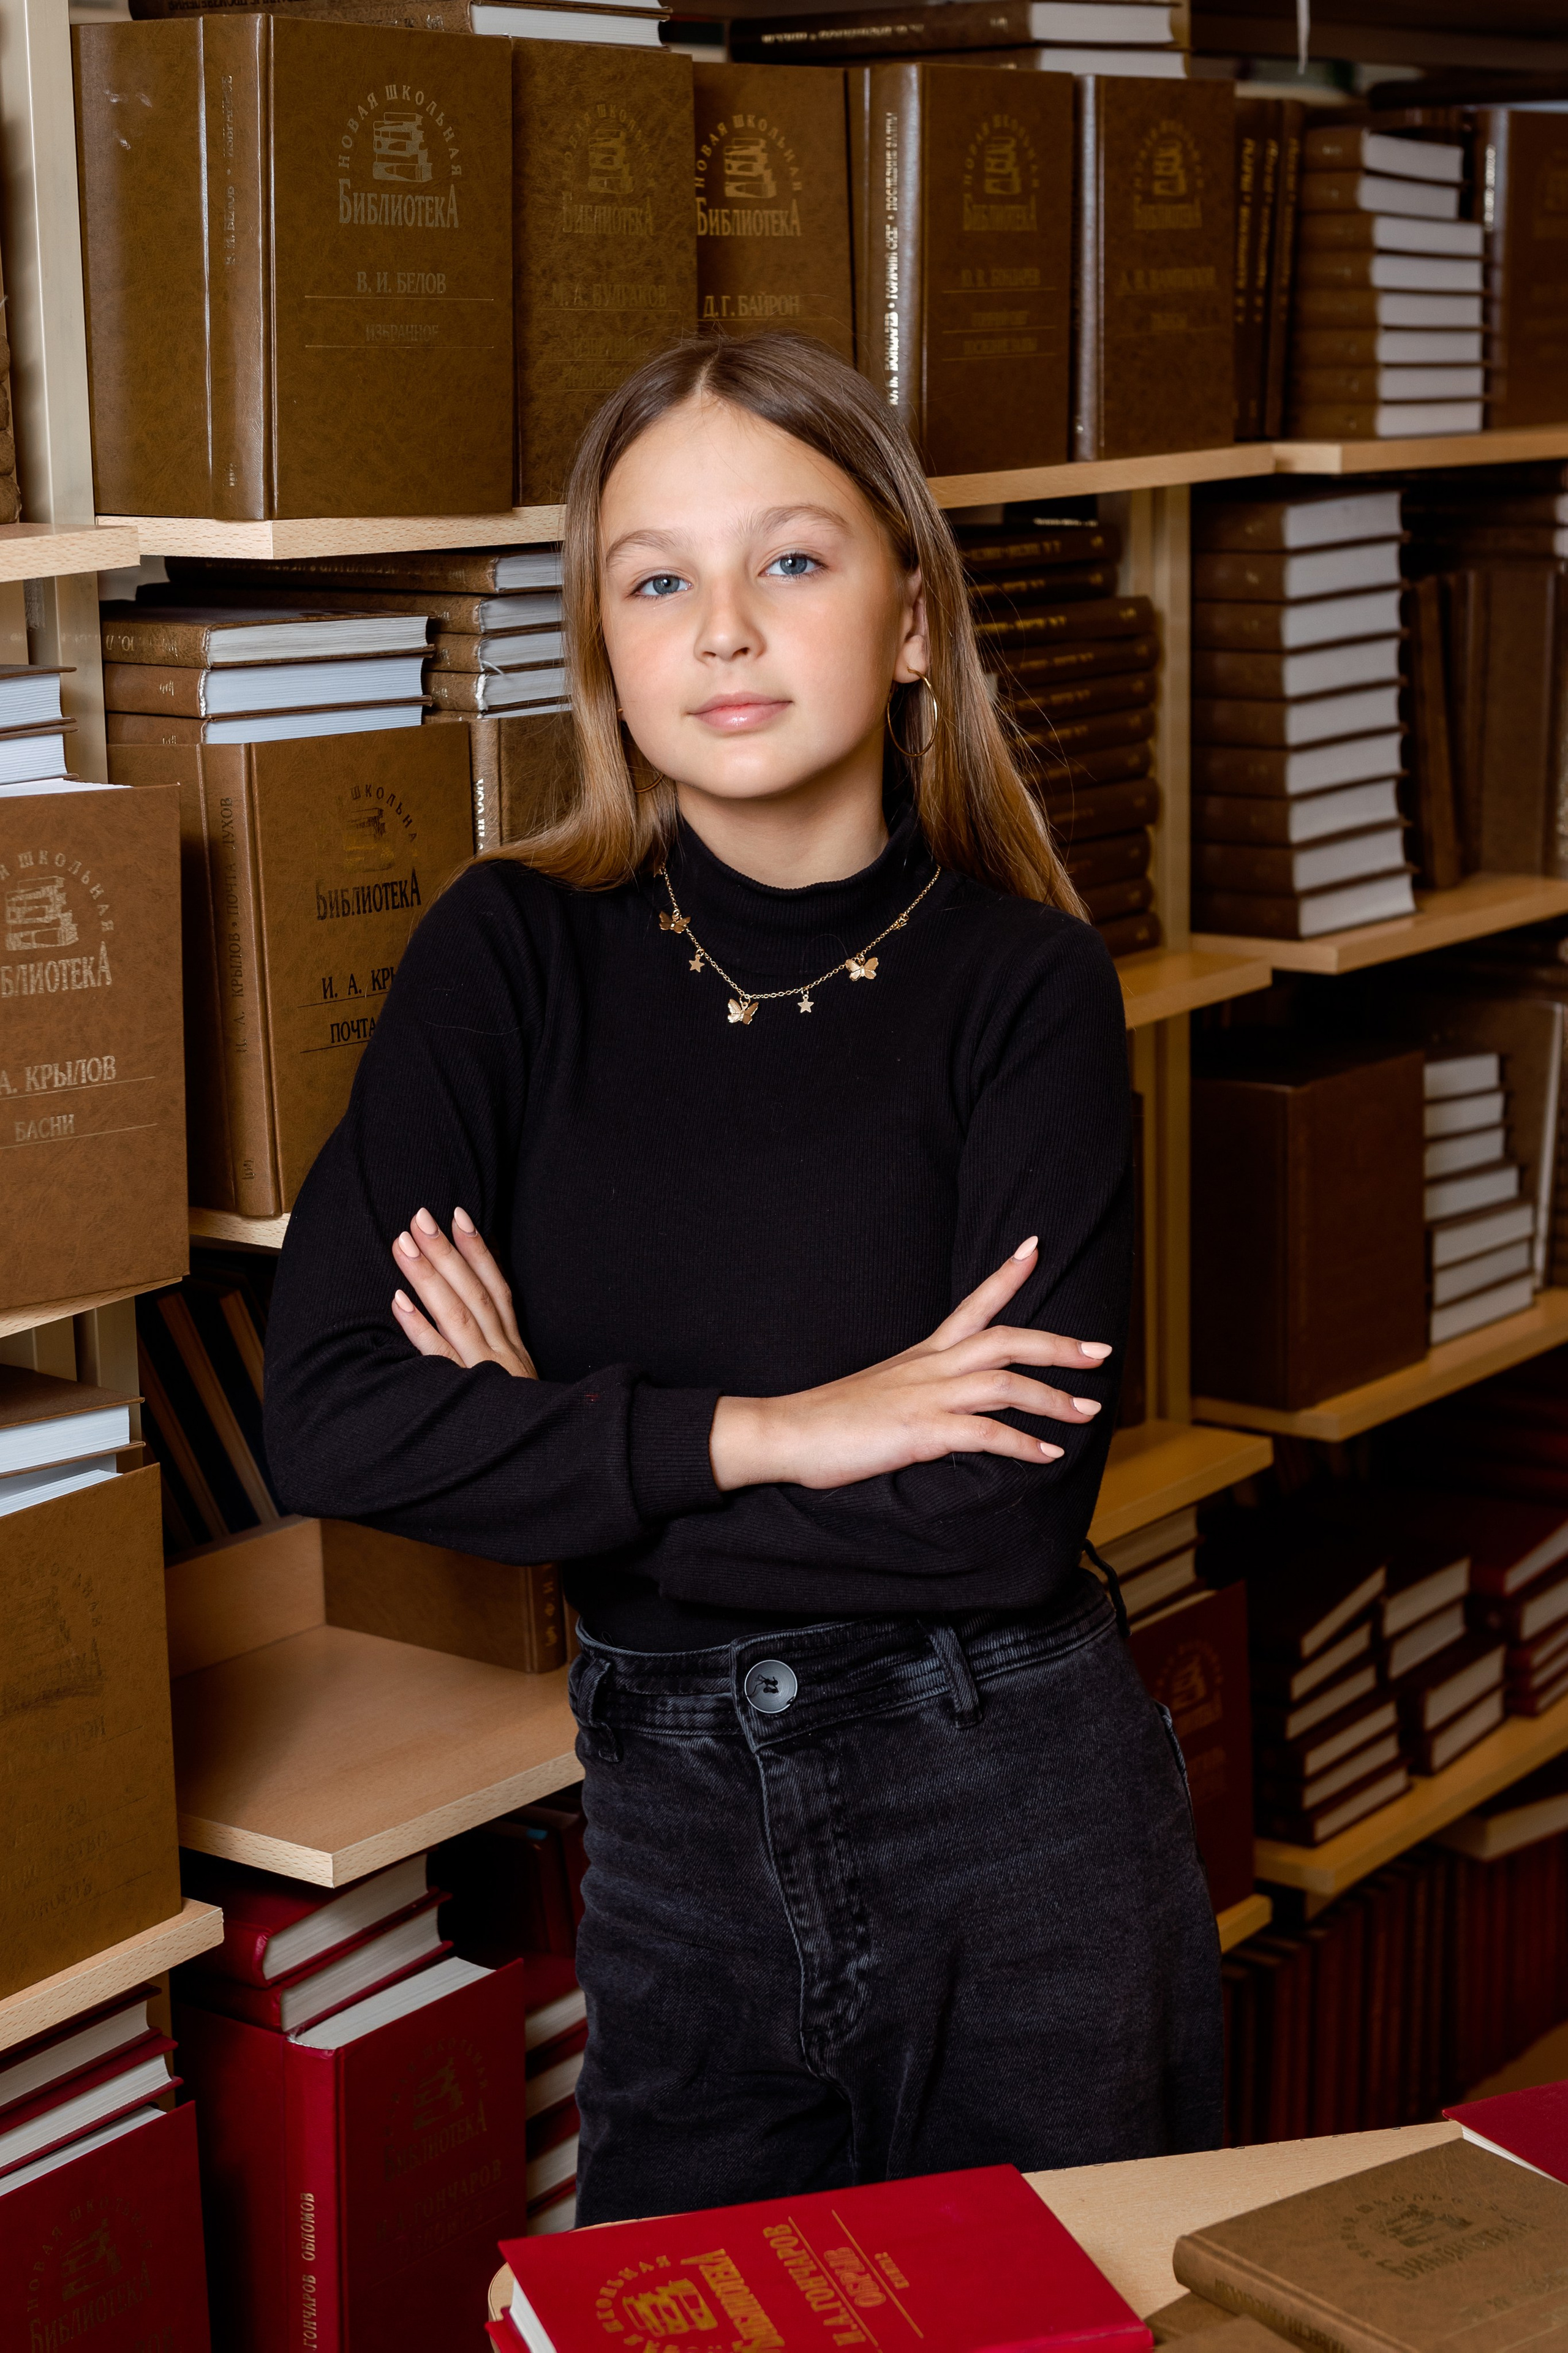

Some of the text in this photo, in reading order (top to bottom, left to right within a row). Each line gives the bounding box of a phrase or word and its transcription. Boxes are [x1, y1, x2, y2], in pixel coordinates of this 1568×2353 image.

[338, 84, 462, 176] НОВАЯ ШКОЛЬНАЯ
[694, 114, 804, 192] НОВАЯ ШКОЛЬНАЯ
[338, 178, 459, 229] БИБЛИОТЕКА
[885, 149, 899, 211] ПОСЛЕДНИЕ
[562, 191, 654, 236] БИБЛИОТЕКА
[696, 197, 802, 237] БИБЛИОТЕКА
[356, 271, 447, 295] В. И. БЕЛОВ
[573, 282, 587, 307] А.
[592, 283, 666, 307] БУЛГАКОВ
[884, 252, 899, 300] ГОРЯЧИЙ
[704, 291, 801, 318] Д. Г. БАЙРОН
[366, 323, 440, 342] ИЗБРАННОЕ
[884, 311, 899, 371] БОНДАРЕВ
[219, 798, 236, 850] ДУХОВ
[18, 849, 115, 932] ШКОЛЬНАЯ
[225, 862, 240, 915] ПОЧТА
[315, 866, 421, 921] БИБЛИОТЕКА
[228, 934, 244, 998] КРЫЛОВ
[322, 976, 339, 1000] И.
[347, 973, 363, 996] А.
[233, 1011, 246, 1027] А.
[330, 1017, 376, 1043] ПОЧТА
[24, 1055, 117, 1092] КРЫЛОВ
[15, 1114, 75, 1143] БАСНИ
[300, 2192, 315, 2262] ОБЛОМОВ
[26, 2226, 63, 2313] НОВАЯ
[823, 2247, 887, 2308] ОБРЫВ
[29, 2260, 151, 2353] БИБЛИОТЕКА
